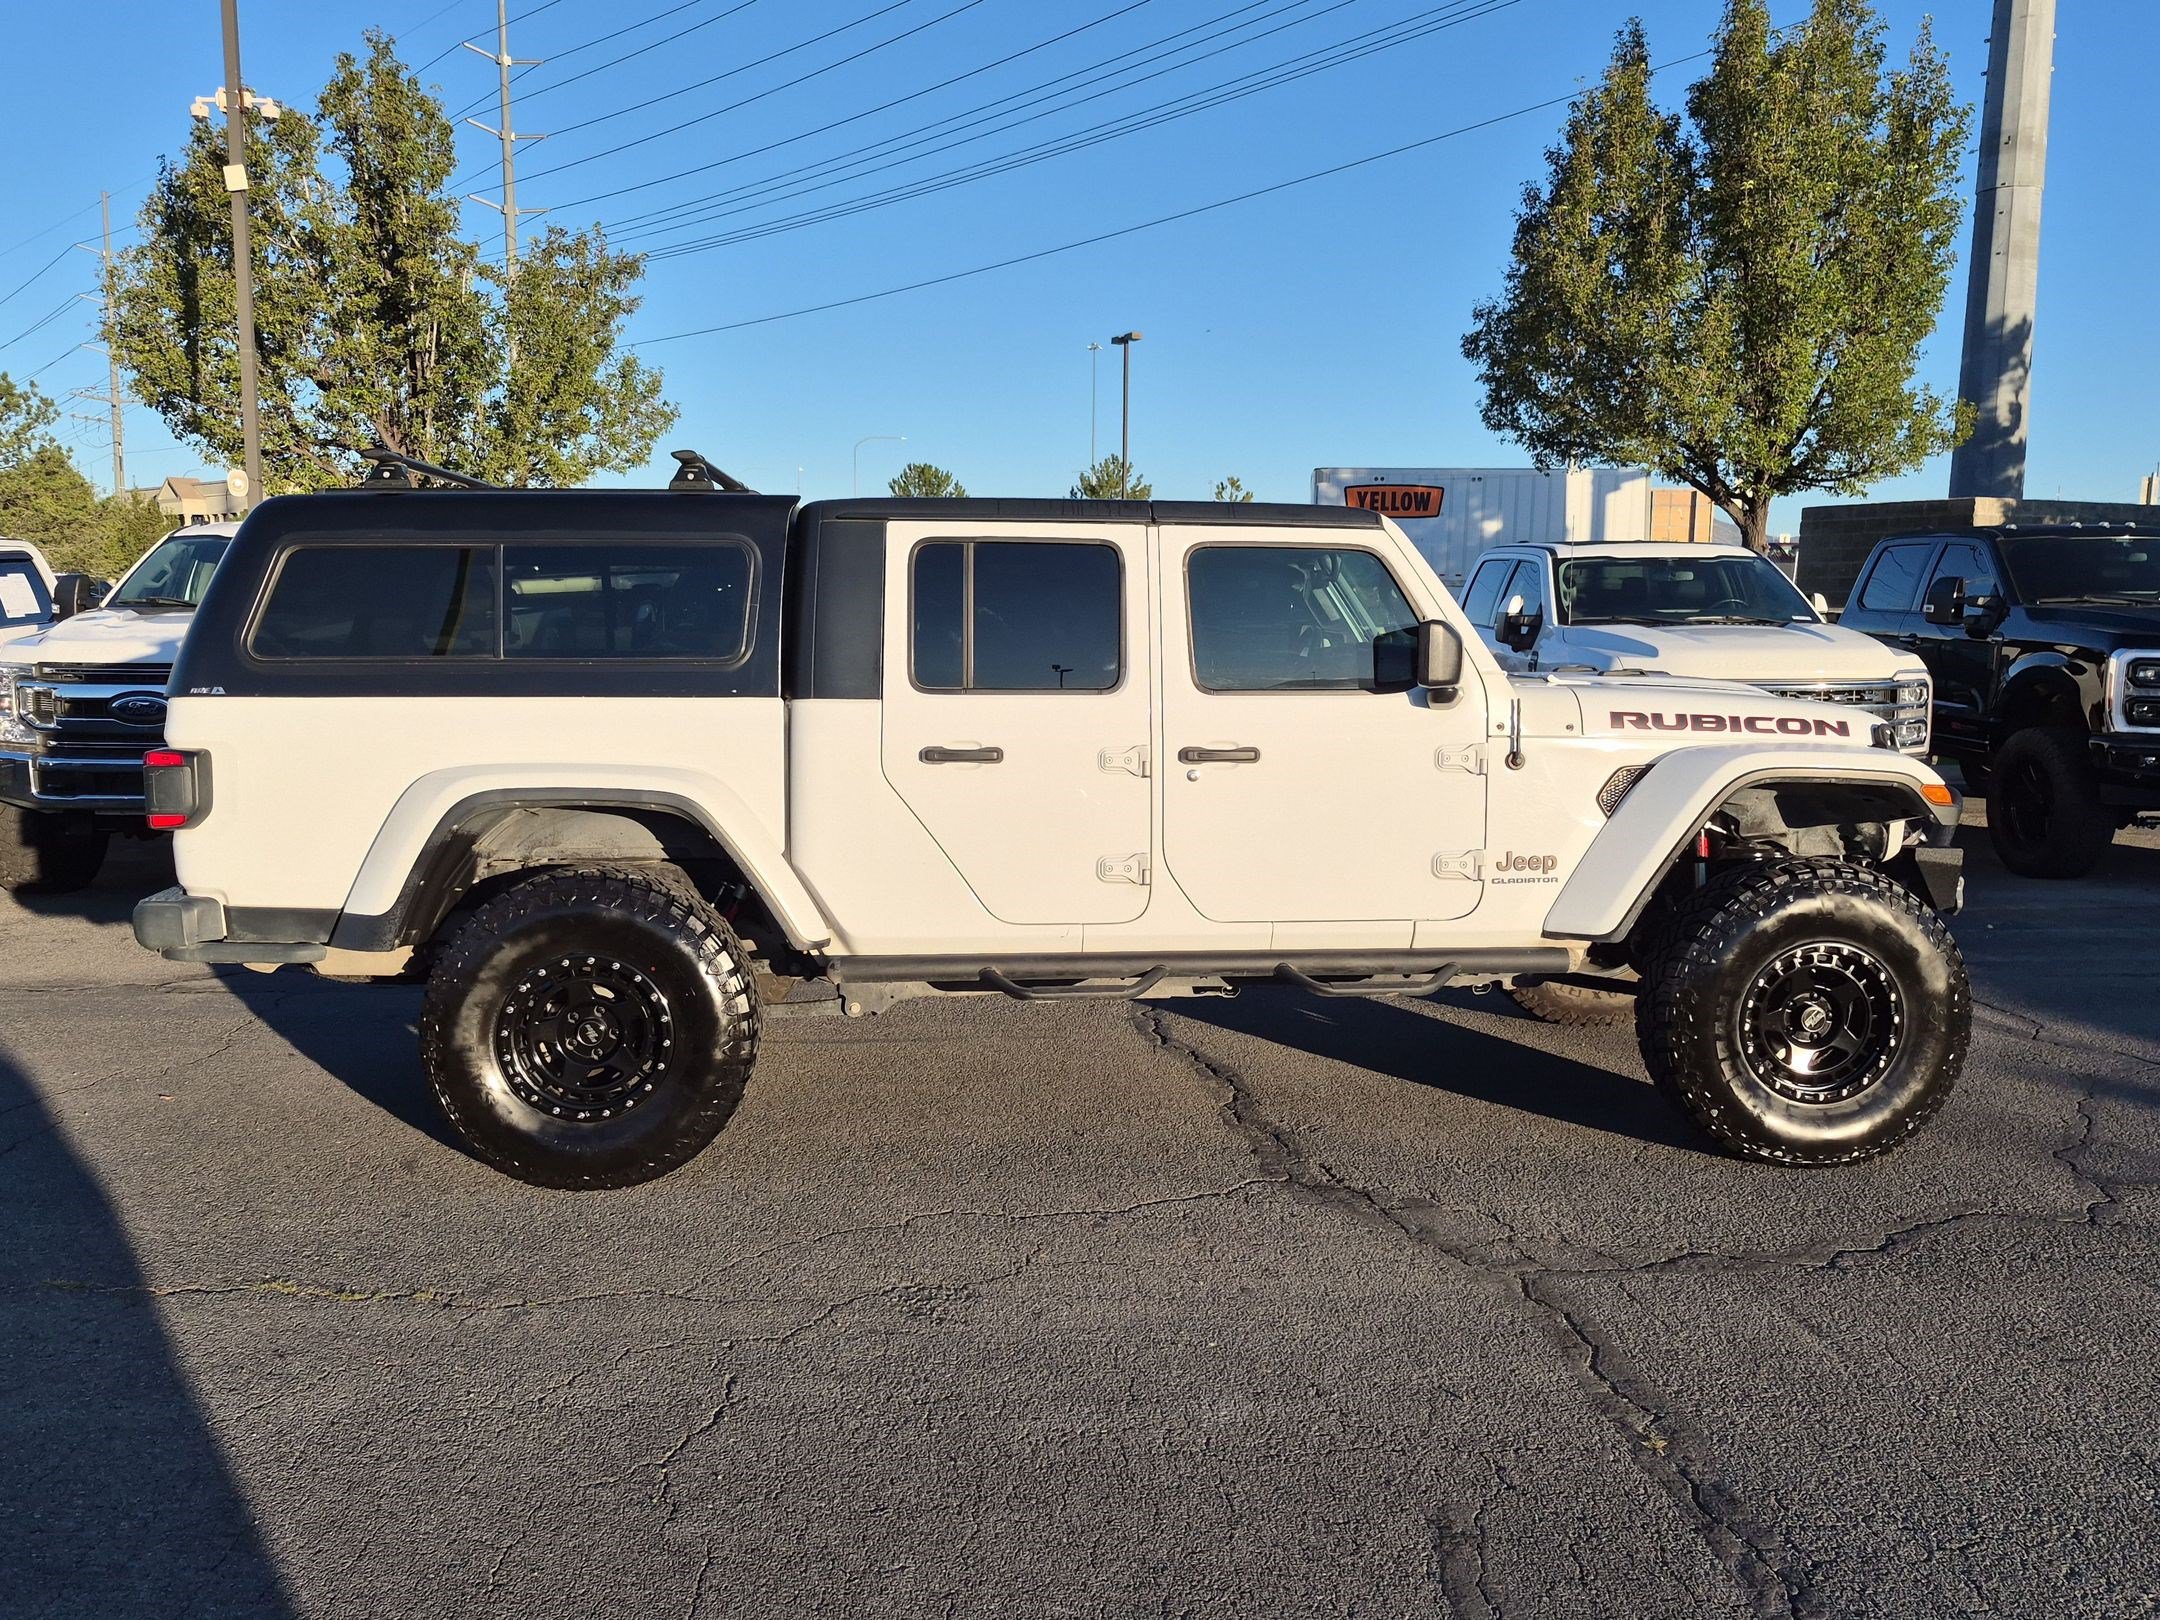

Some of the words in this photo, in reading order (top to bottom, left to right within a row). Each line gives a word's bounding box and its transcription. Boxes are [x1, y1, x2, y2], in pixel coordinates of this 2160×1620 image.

[1356, 491, 1432, 512] YELLOW
[1609, 711, 1851, 737] RUBICON
[1495, 850, 1558, 875] Jeep
[1491, 877, 1559, 885] GLADIATOR
